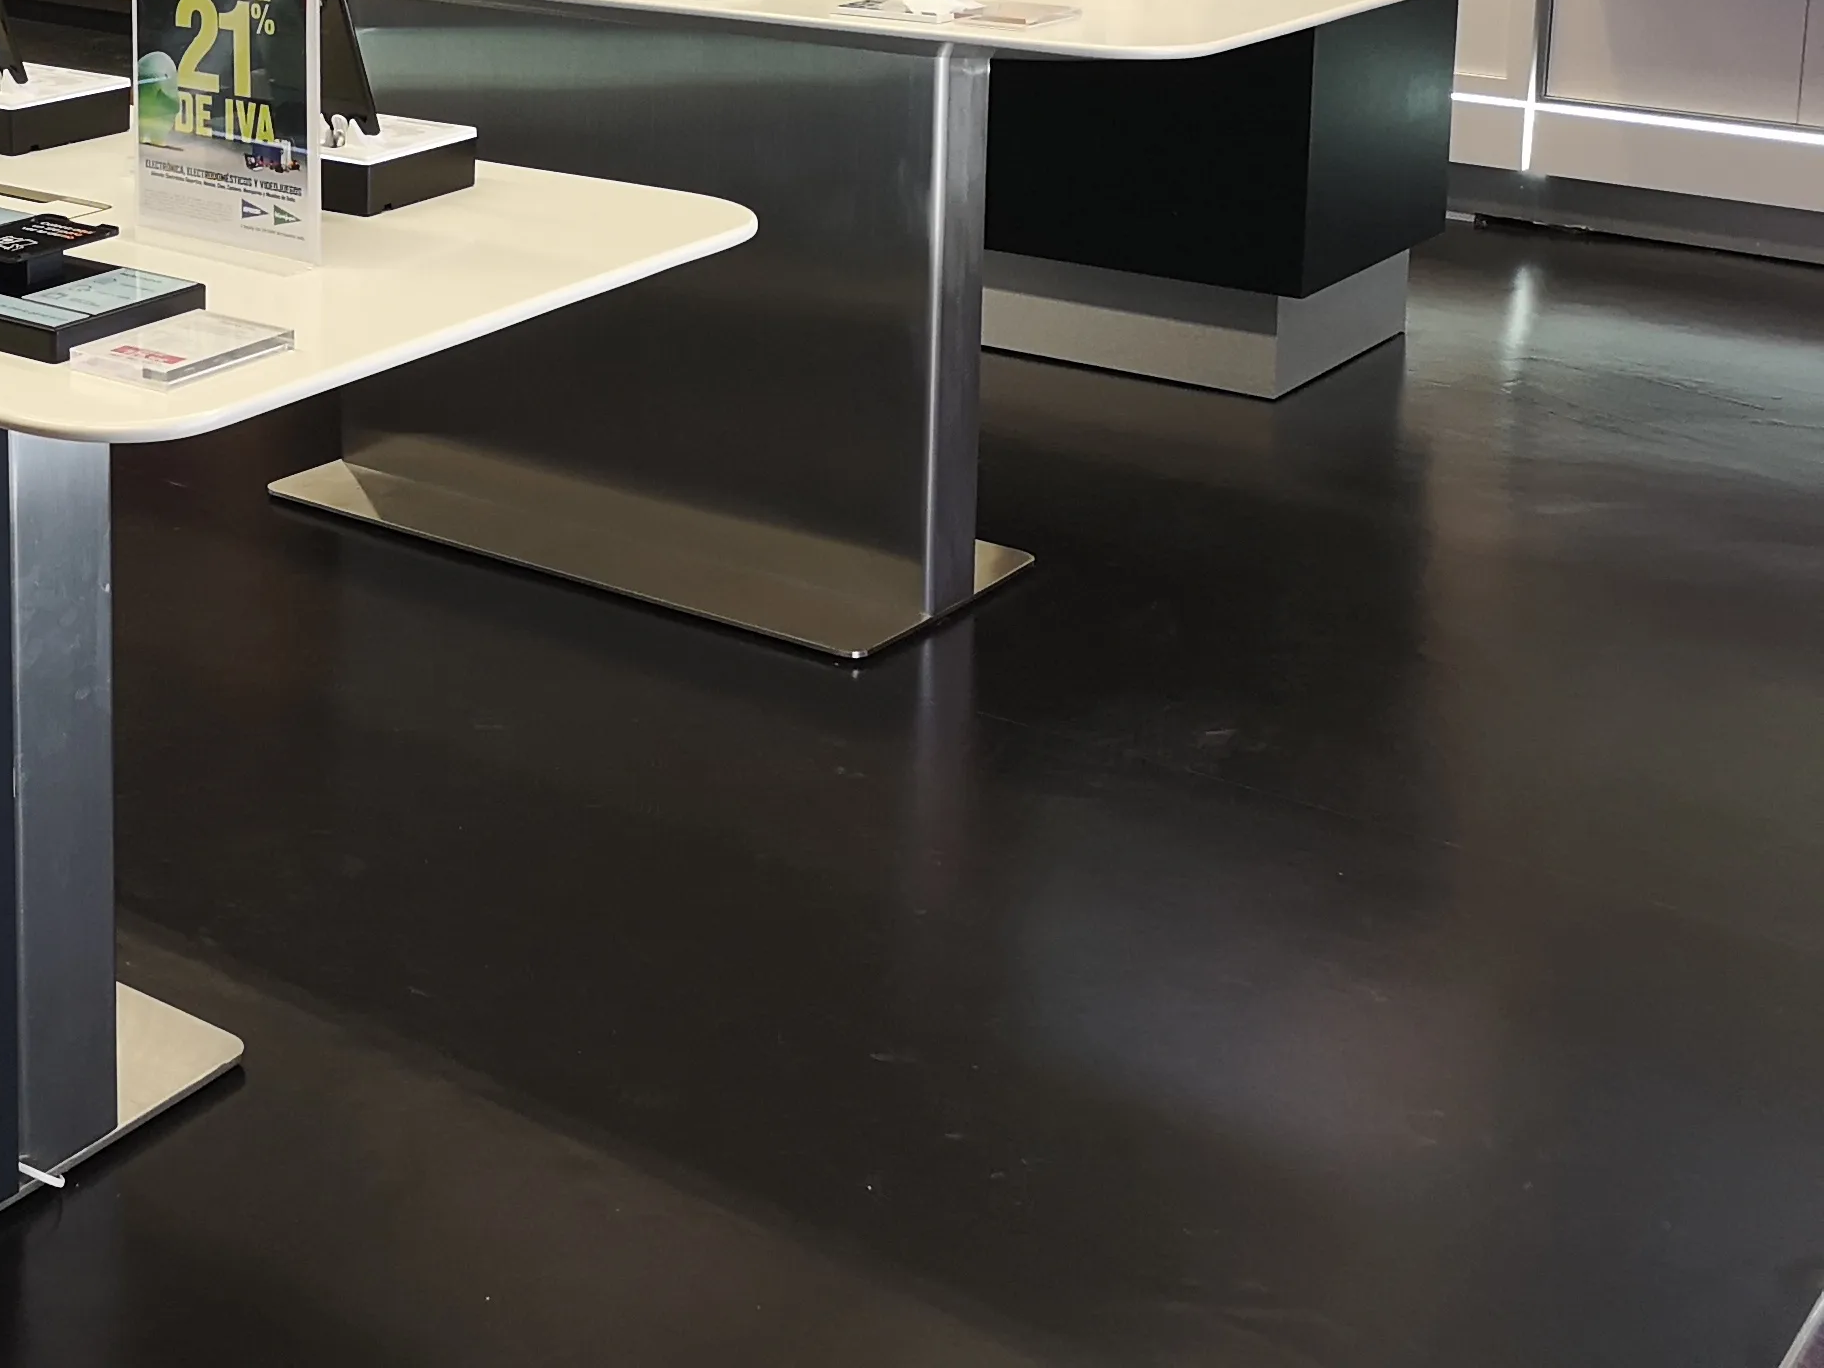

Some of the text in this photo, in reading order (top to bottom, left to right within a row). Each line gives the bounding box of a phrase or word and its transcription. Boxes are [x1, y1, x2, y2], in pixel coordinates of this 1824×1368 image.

[176, 92, 275, 143] DE IVA
[145, 159, 186, 175] ELECTRÓNICA,
[186, 168, 252, 187] ELECTRODOMÉSTICOS
